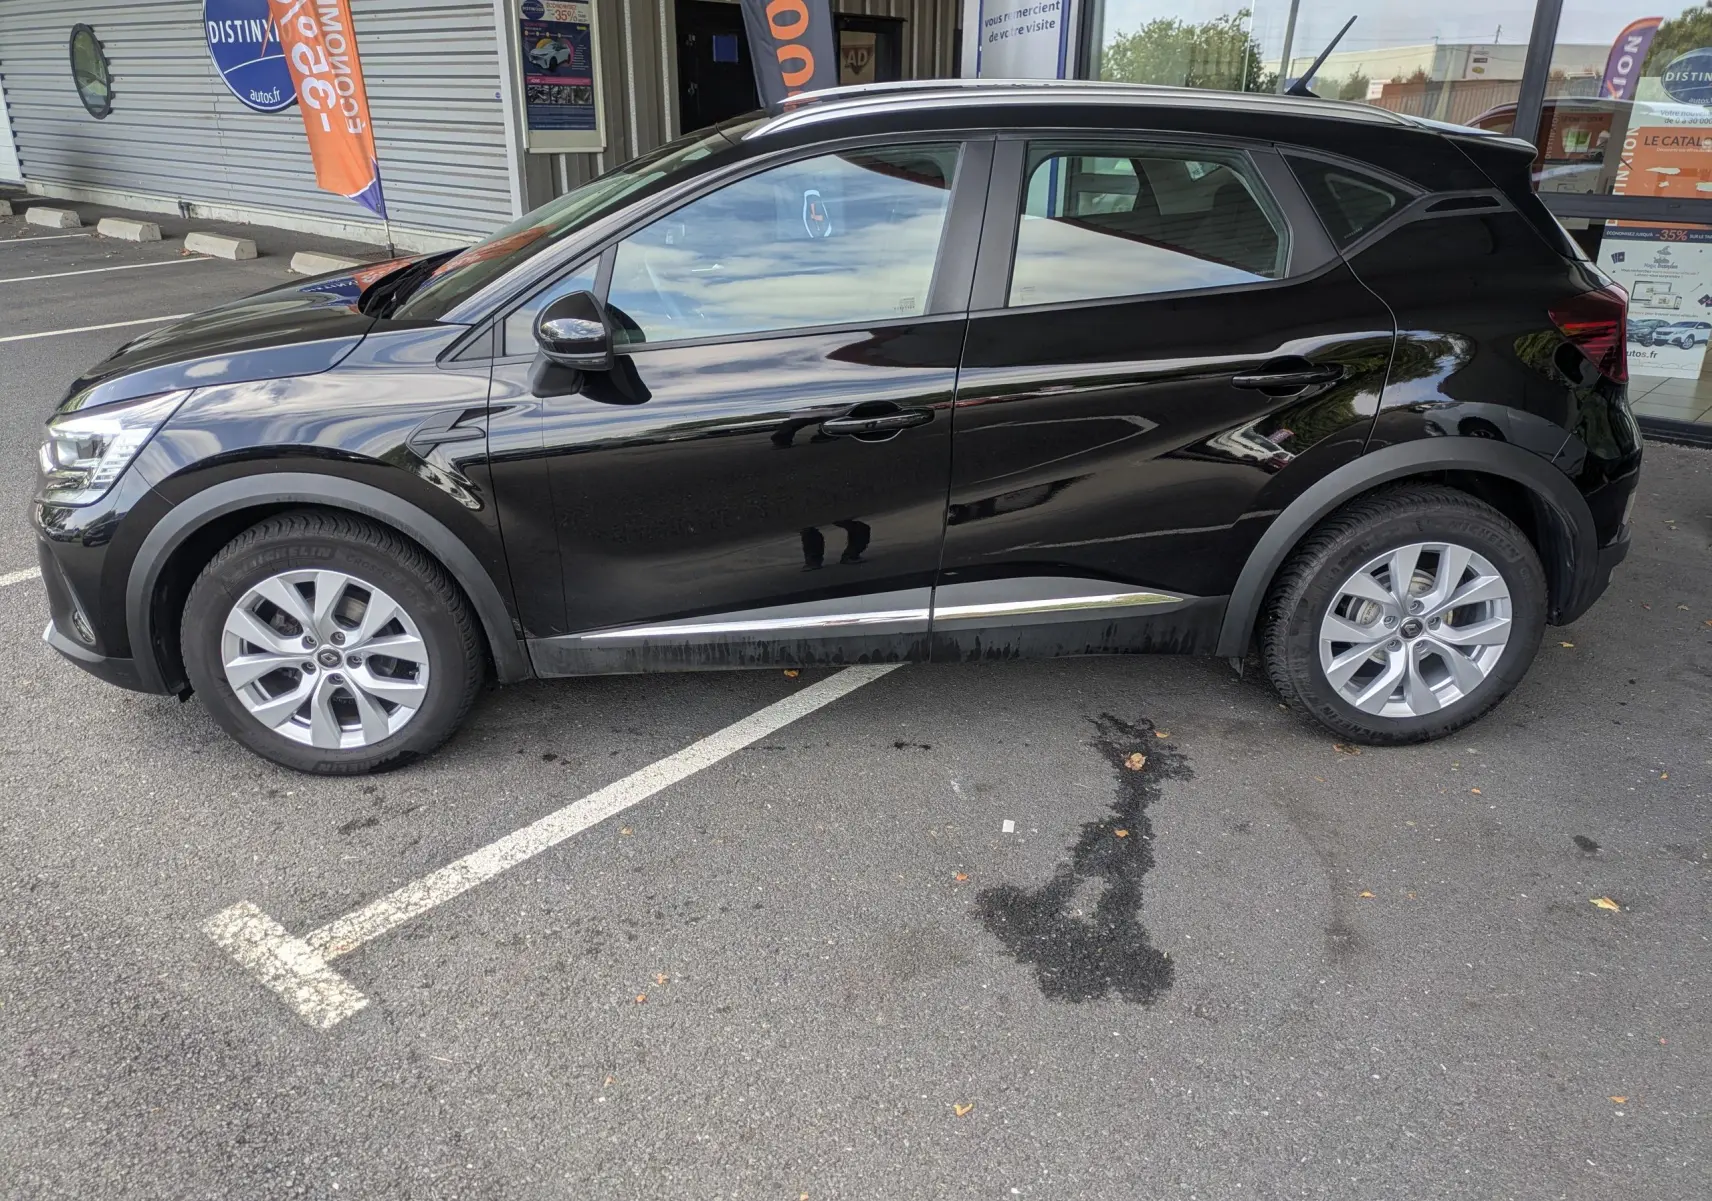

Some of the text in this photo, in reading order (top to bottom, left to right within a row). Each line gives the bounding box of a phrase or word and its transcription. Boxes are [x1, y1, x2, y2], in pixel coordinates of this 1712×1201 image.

[984, 14, 1002, 27] vous
[988, 31, 999, 43] de
[1026, 19, 1056, 33] visite
[846, 49, 868, 66] AD
[249, 86, 281, 104] autos.fr
[1644, 136, 1660, 146] LE
[1655, 229, 1688, 240] -35%
[1627, 349, 1658, 359] utos.fr
